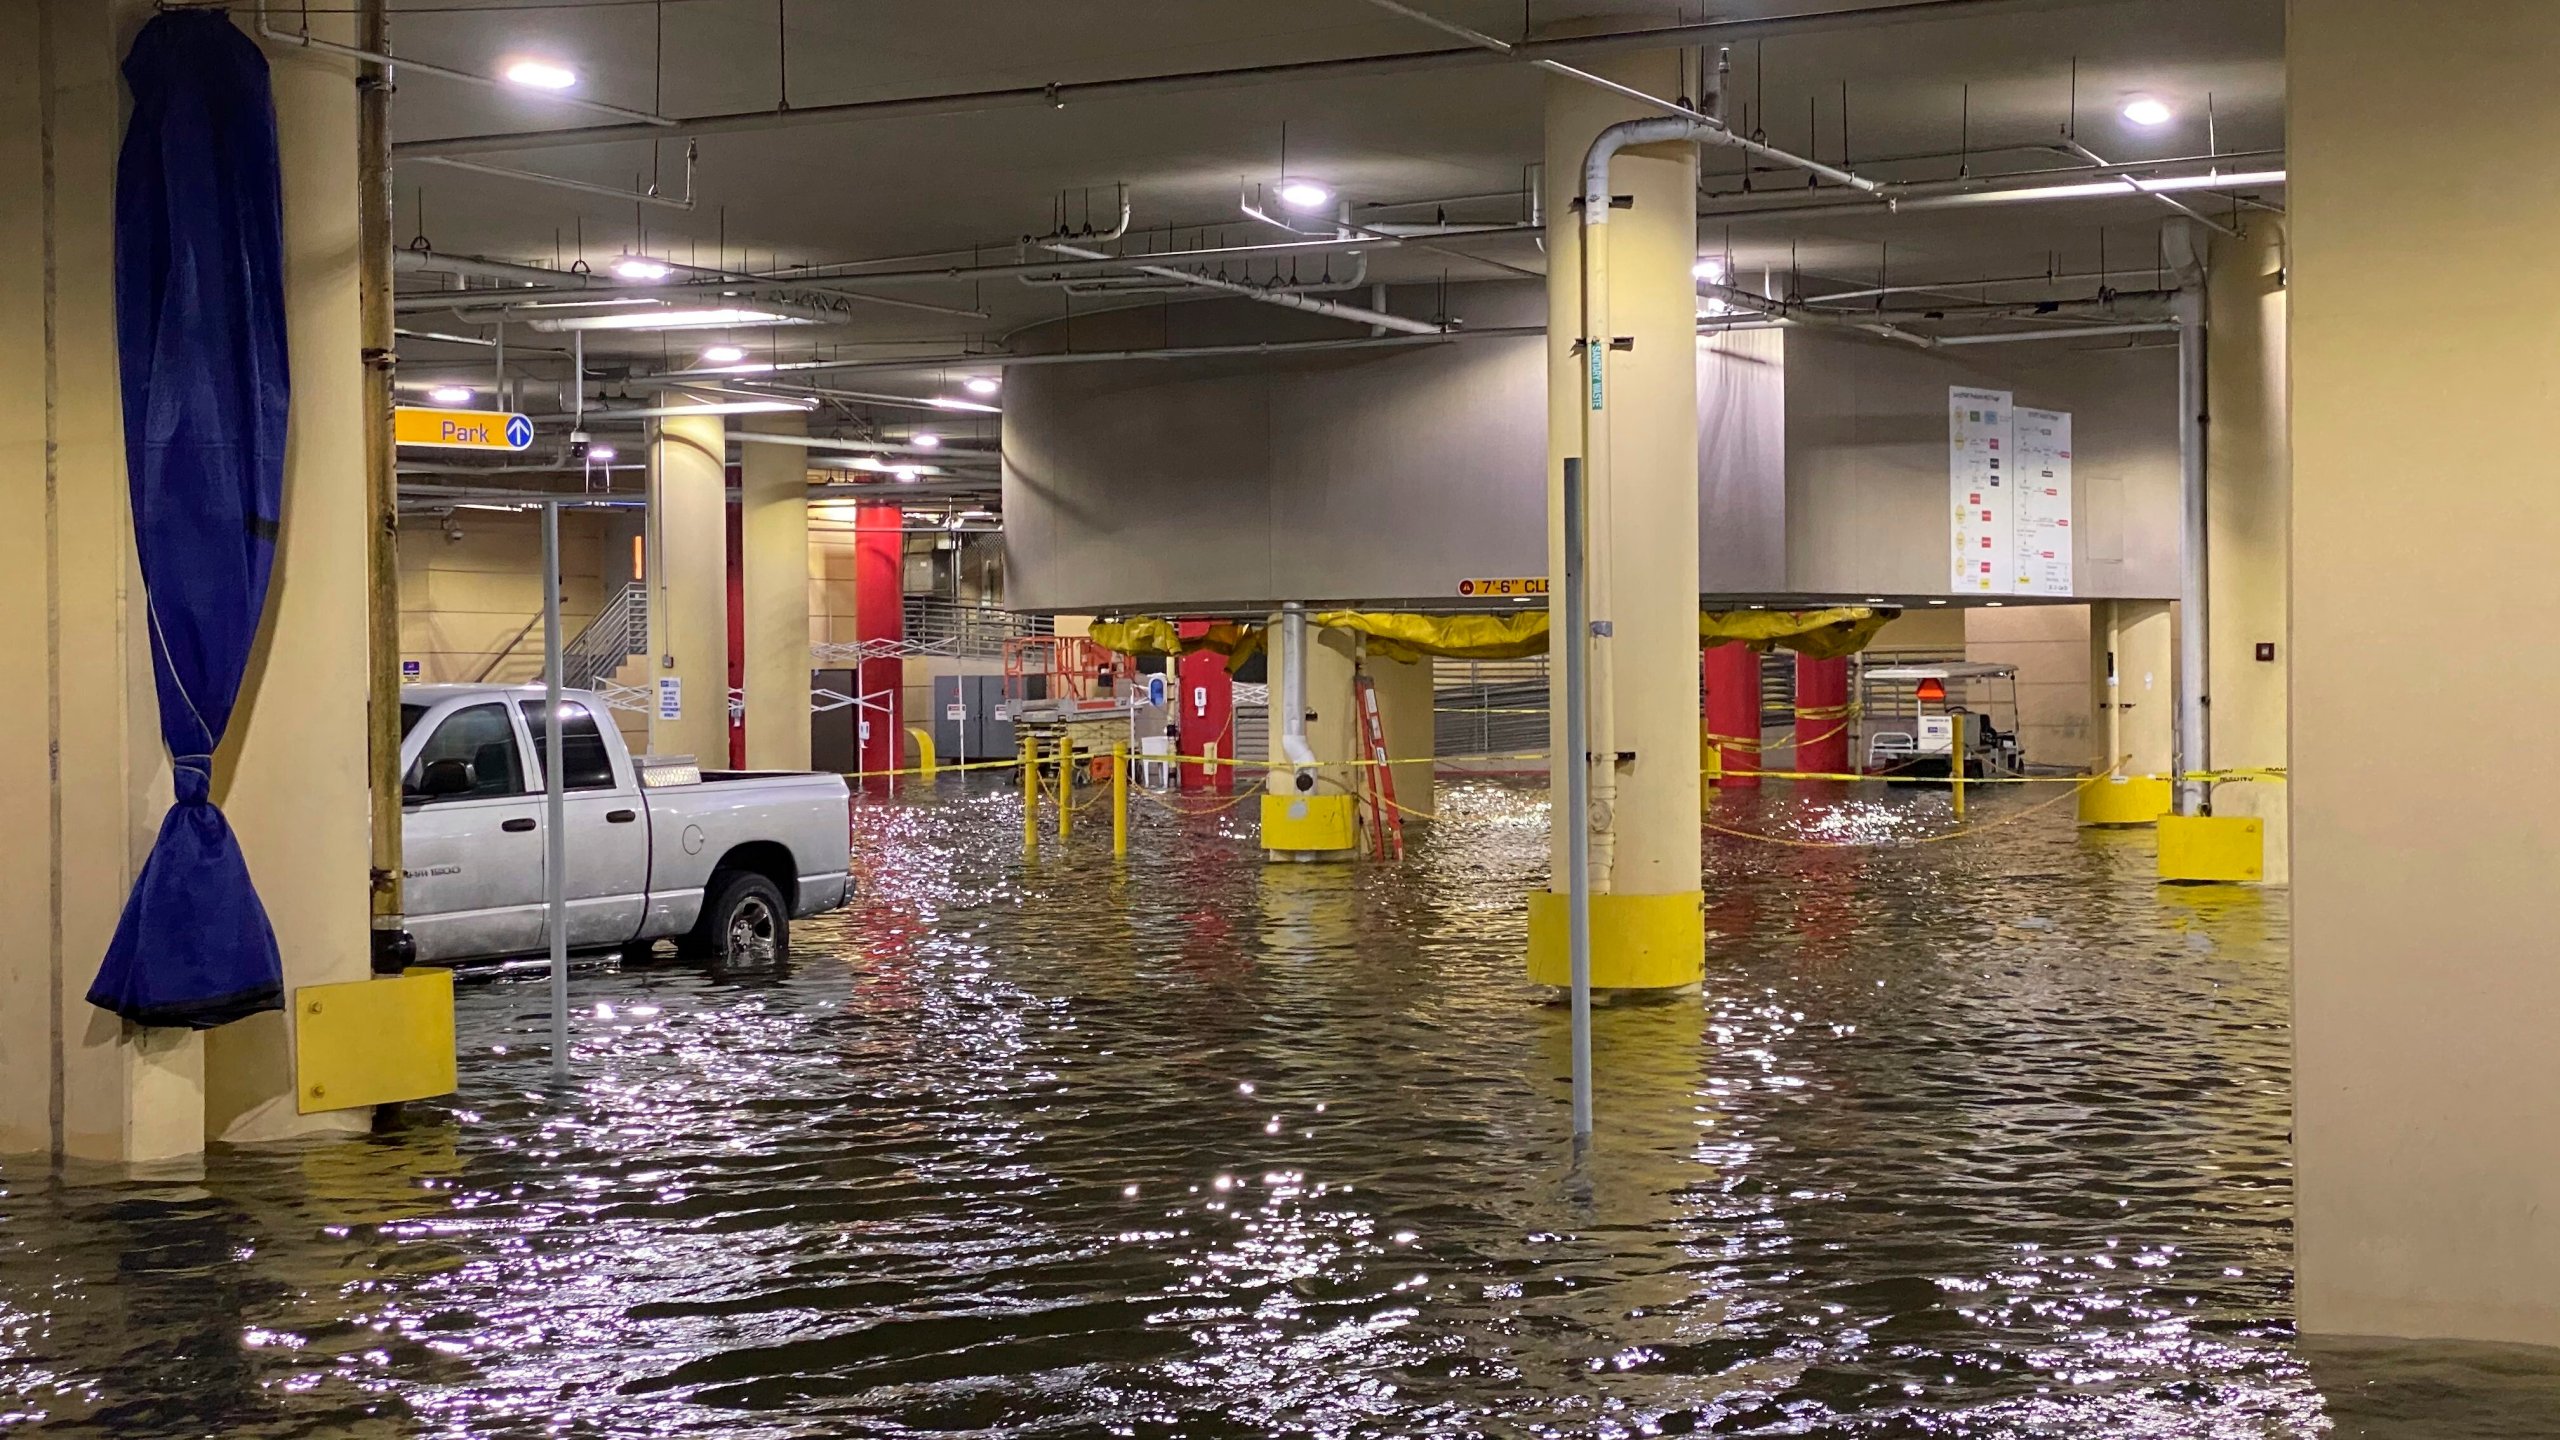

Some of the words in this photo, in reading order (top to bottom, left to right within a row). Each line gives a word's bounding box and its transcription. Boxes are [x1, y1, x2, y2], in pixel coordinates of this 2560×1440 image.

[1592, 345, 1601, 380] SANITARY
[1592, 383, 1602, 407] WASTE
[441, 421, 489, 443] Park
